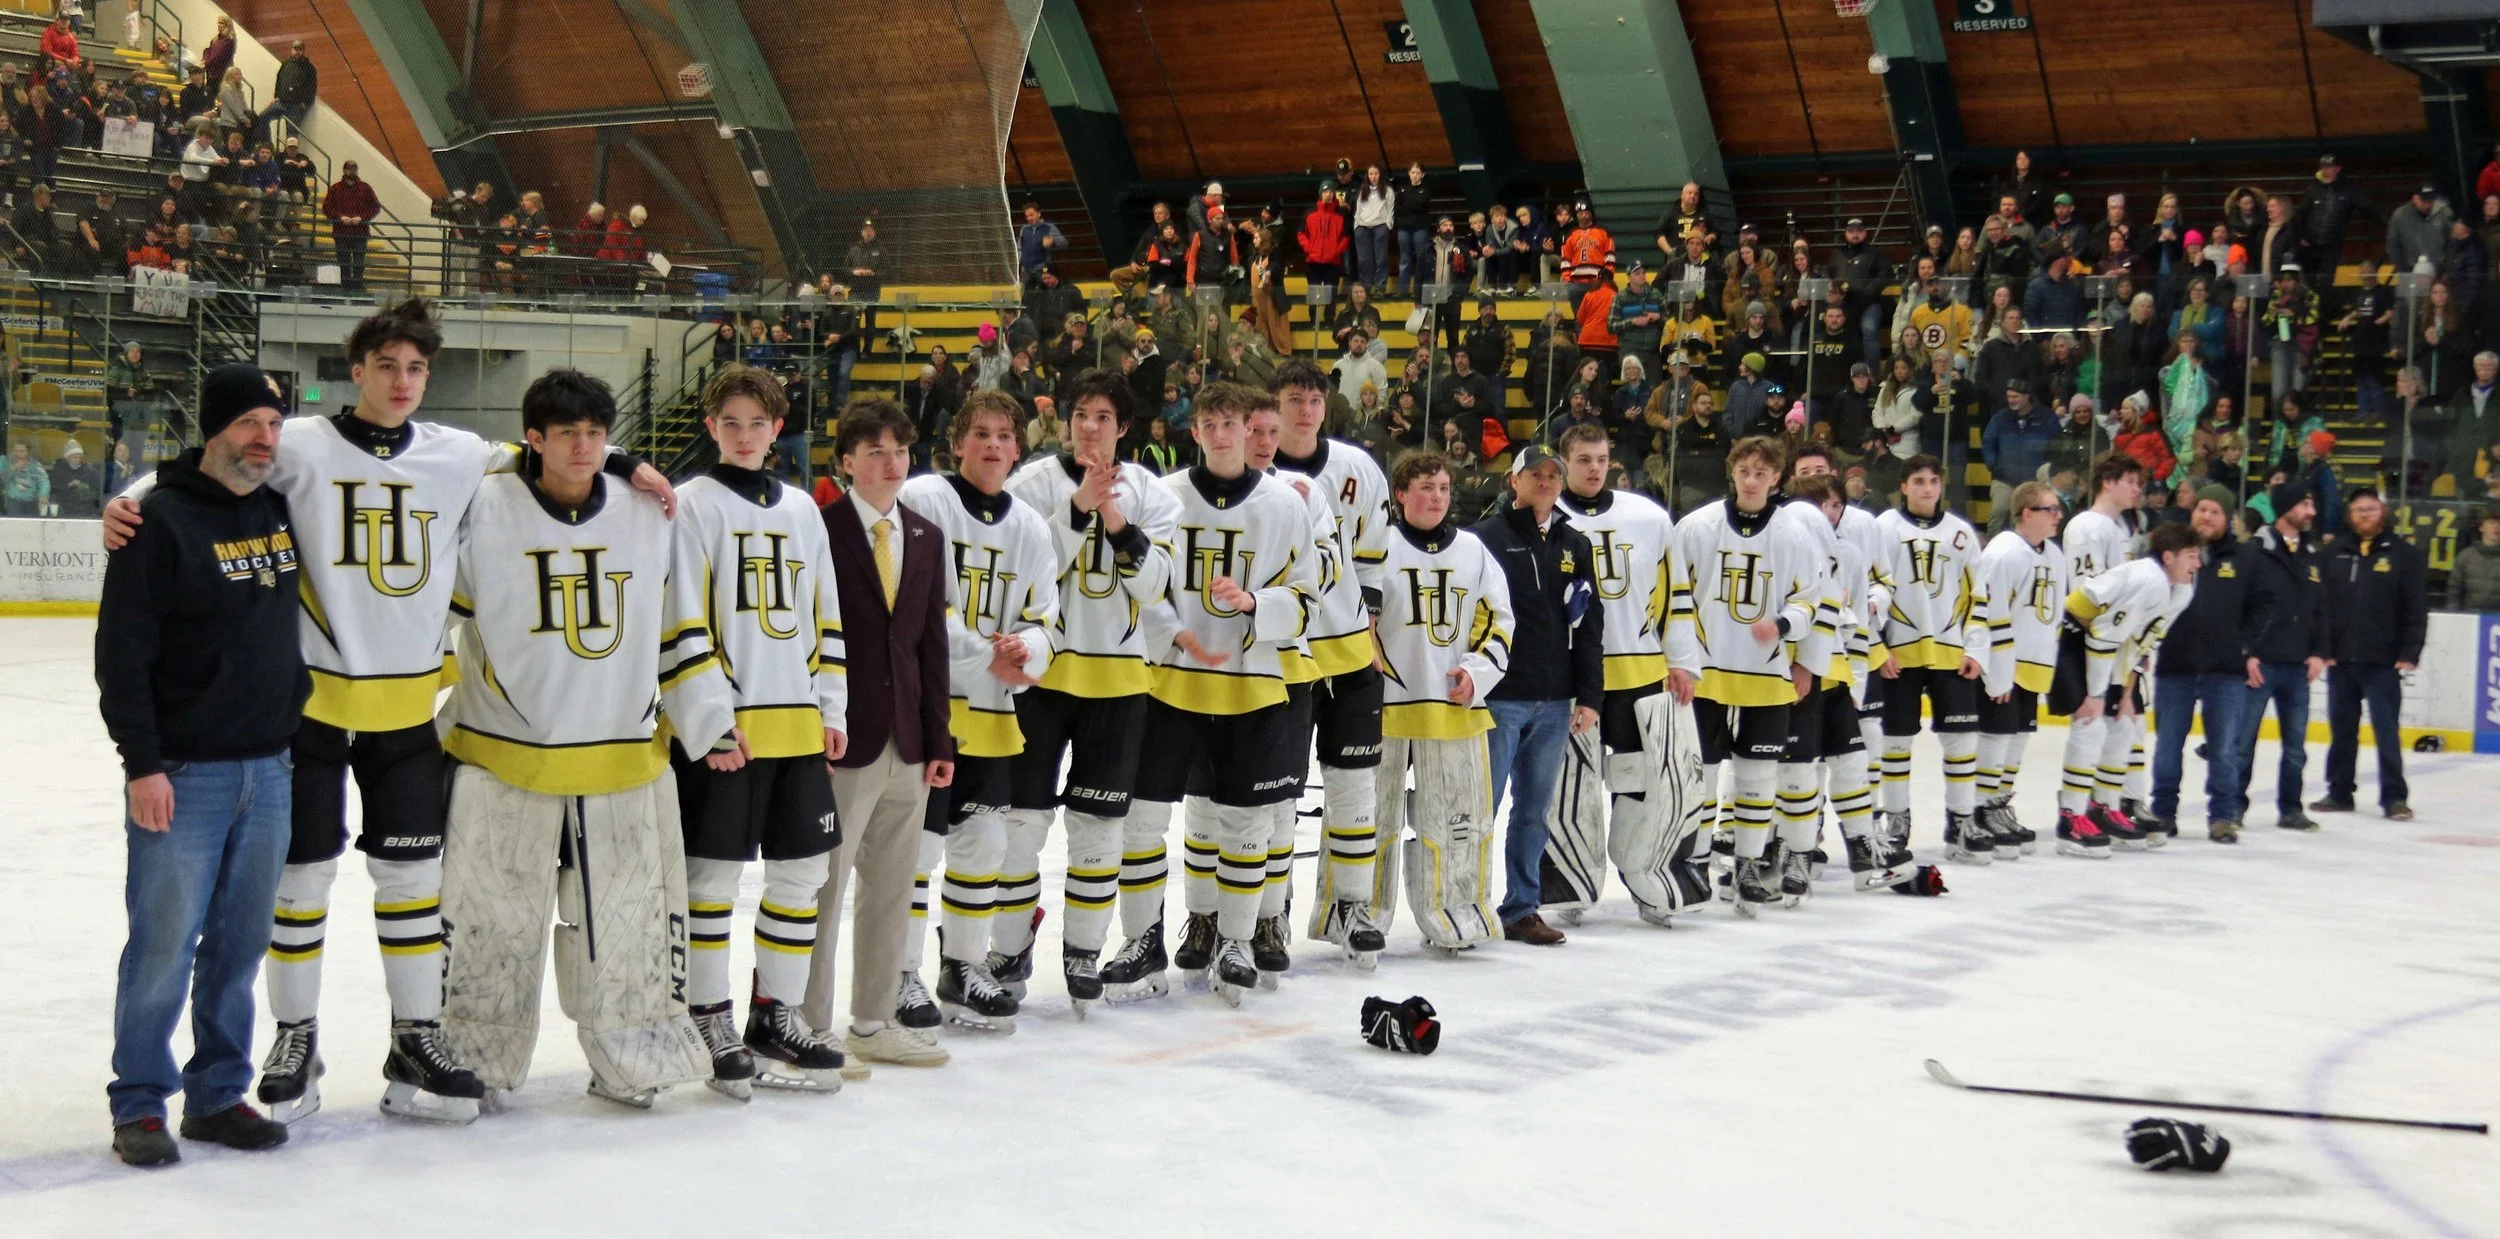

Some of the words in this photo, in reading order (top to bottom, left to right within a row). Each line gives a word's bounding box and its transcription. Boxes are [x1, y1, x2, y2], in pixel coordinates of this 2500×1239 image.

[1400, 24, 1417, 46] 2
[1953, 18, 2028, 32] RESERVED
[1389, 52, 1421, 62] RESE
[1929, 329, 1940, 343] B
[375, 446, 391, 457] 22
[1339, 476, 1358, 505] A
[570, 510, 578, 522] 1
[214, 532, 293, 560] HARWOD
[332, 480, 438, 597] HU
[1953, 530, 1968, 550] C
[5, 551, 98, 568] VERMONT
[221, 549, 296, 573] HOCEY
[1901, 538, 1950, 599] HU
[2075, 553, 2093, 576] 24
[18, 571, 106, 581] INSURANCE
[1181, 526, 1255, 618] HU
[732, 531, 805, 640] HU
[1714, 550, 1774, 624] HU
[524, 547, 633, 660] HU
[1400, 568, 1469, 647] HU
[2112, 611, 2126, 626] 6
[1751, 745, 1784, 753] CCM
[1071, 786, 1128, 803] BAUER
[383, 835, 441, 847] BAUER
[669, 912, 687, 1004] CCM
